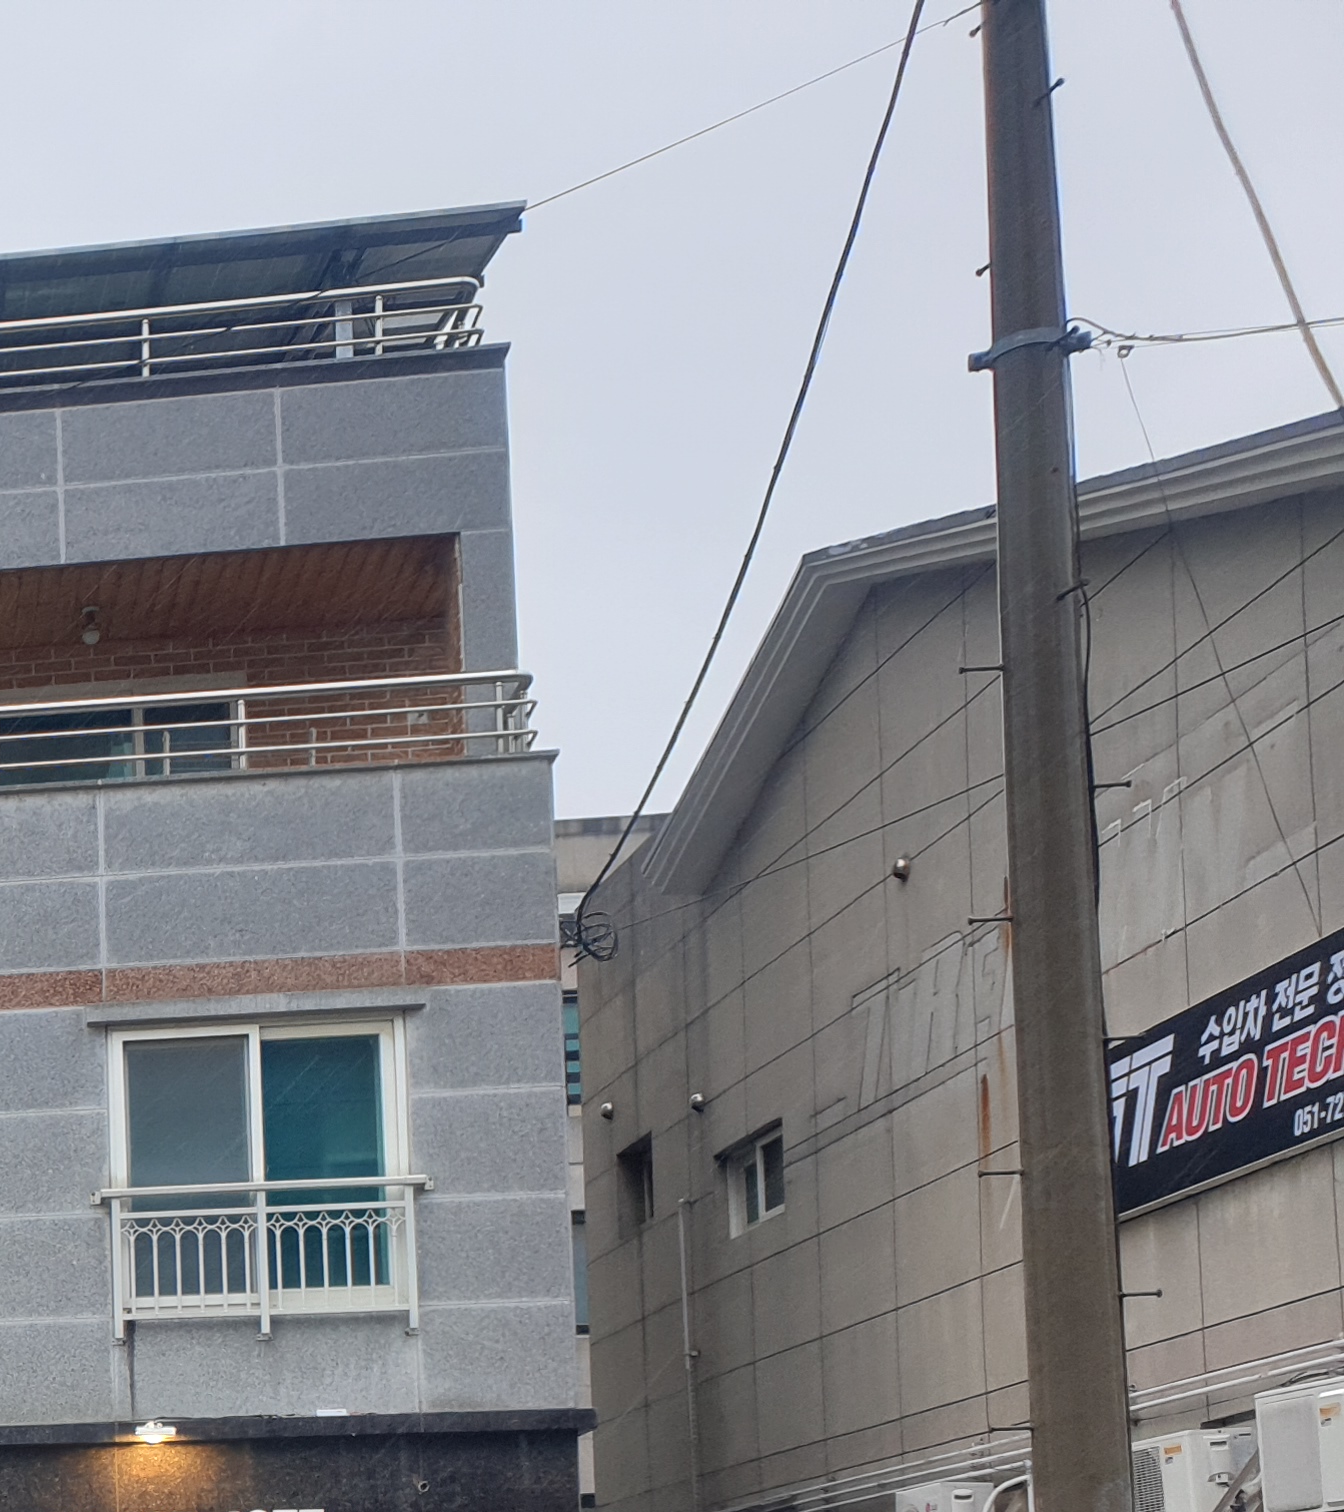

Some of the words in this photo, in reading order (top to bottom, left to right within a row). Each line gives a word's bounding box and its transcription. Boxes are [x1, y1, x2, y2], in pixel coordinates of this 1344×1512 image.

[1198, 989, 1266, 1065] 수입차
[1272, 961, 1321, 1033] 전문
[1155, 1053, 1257, 1154] AUTO
